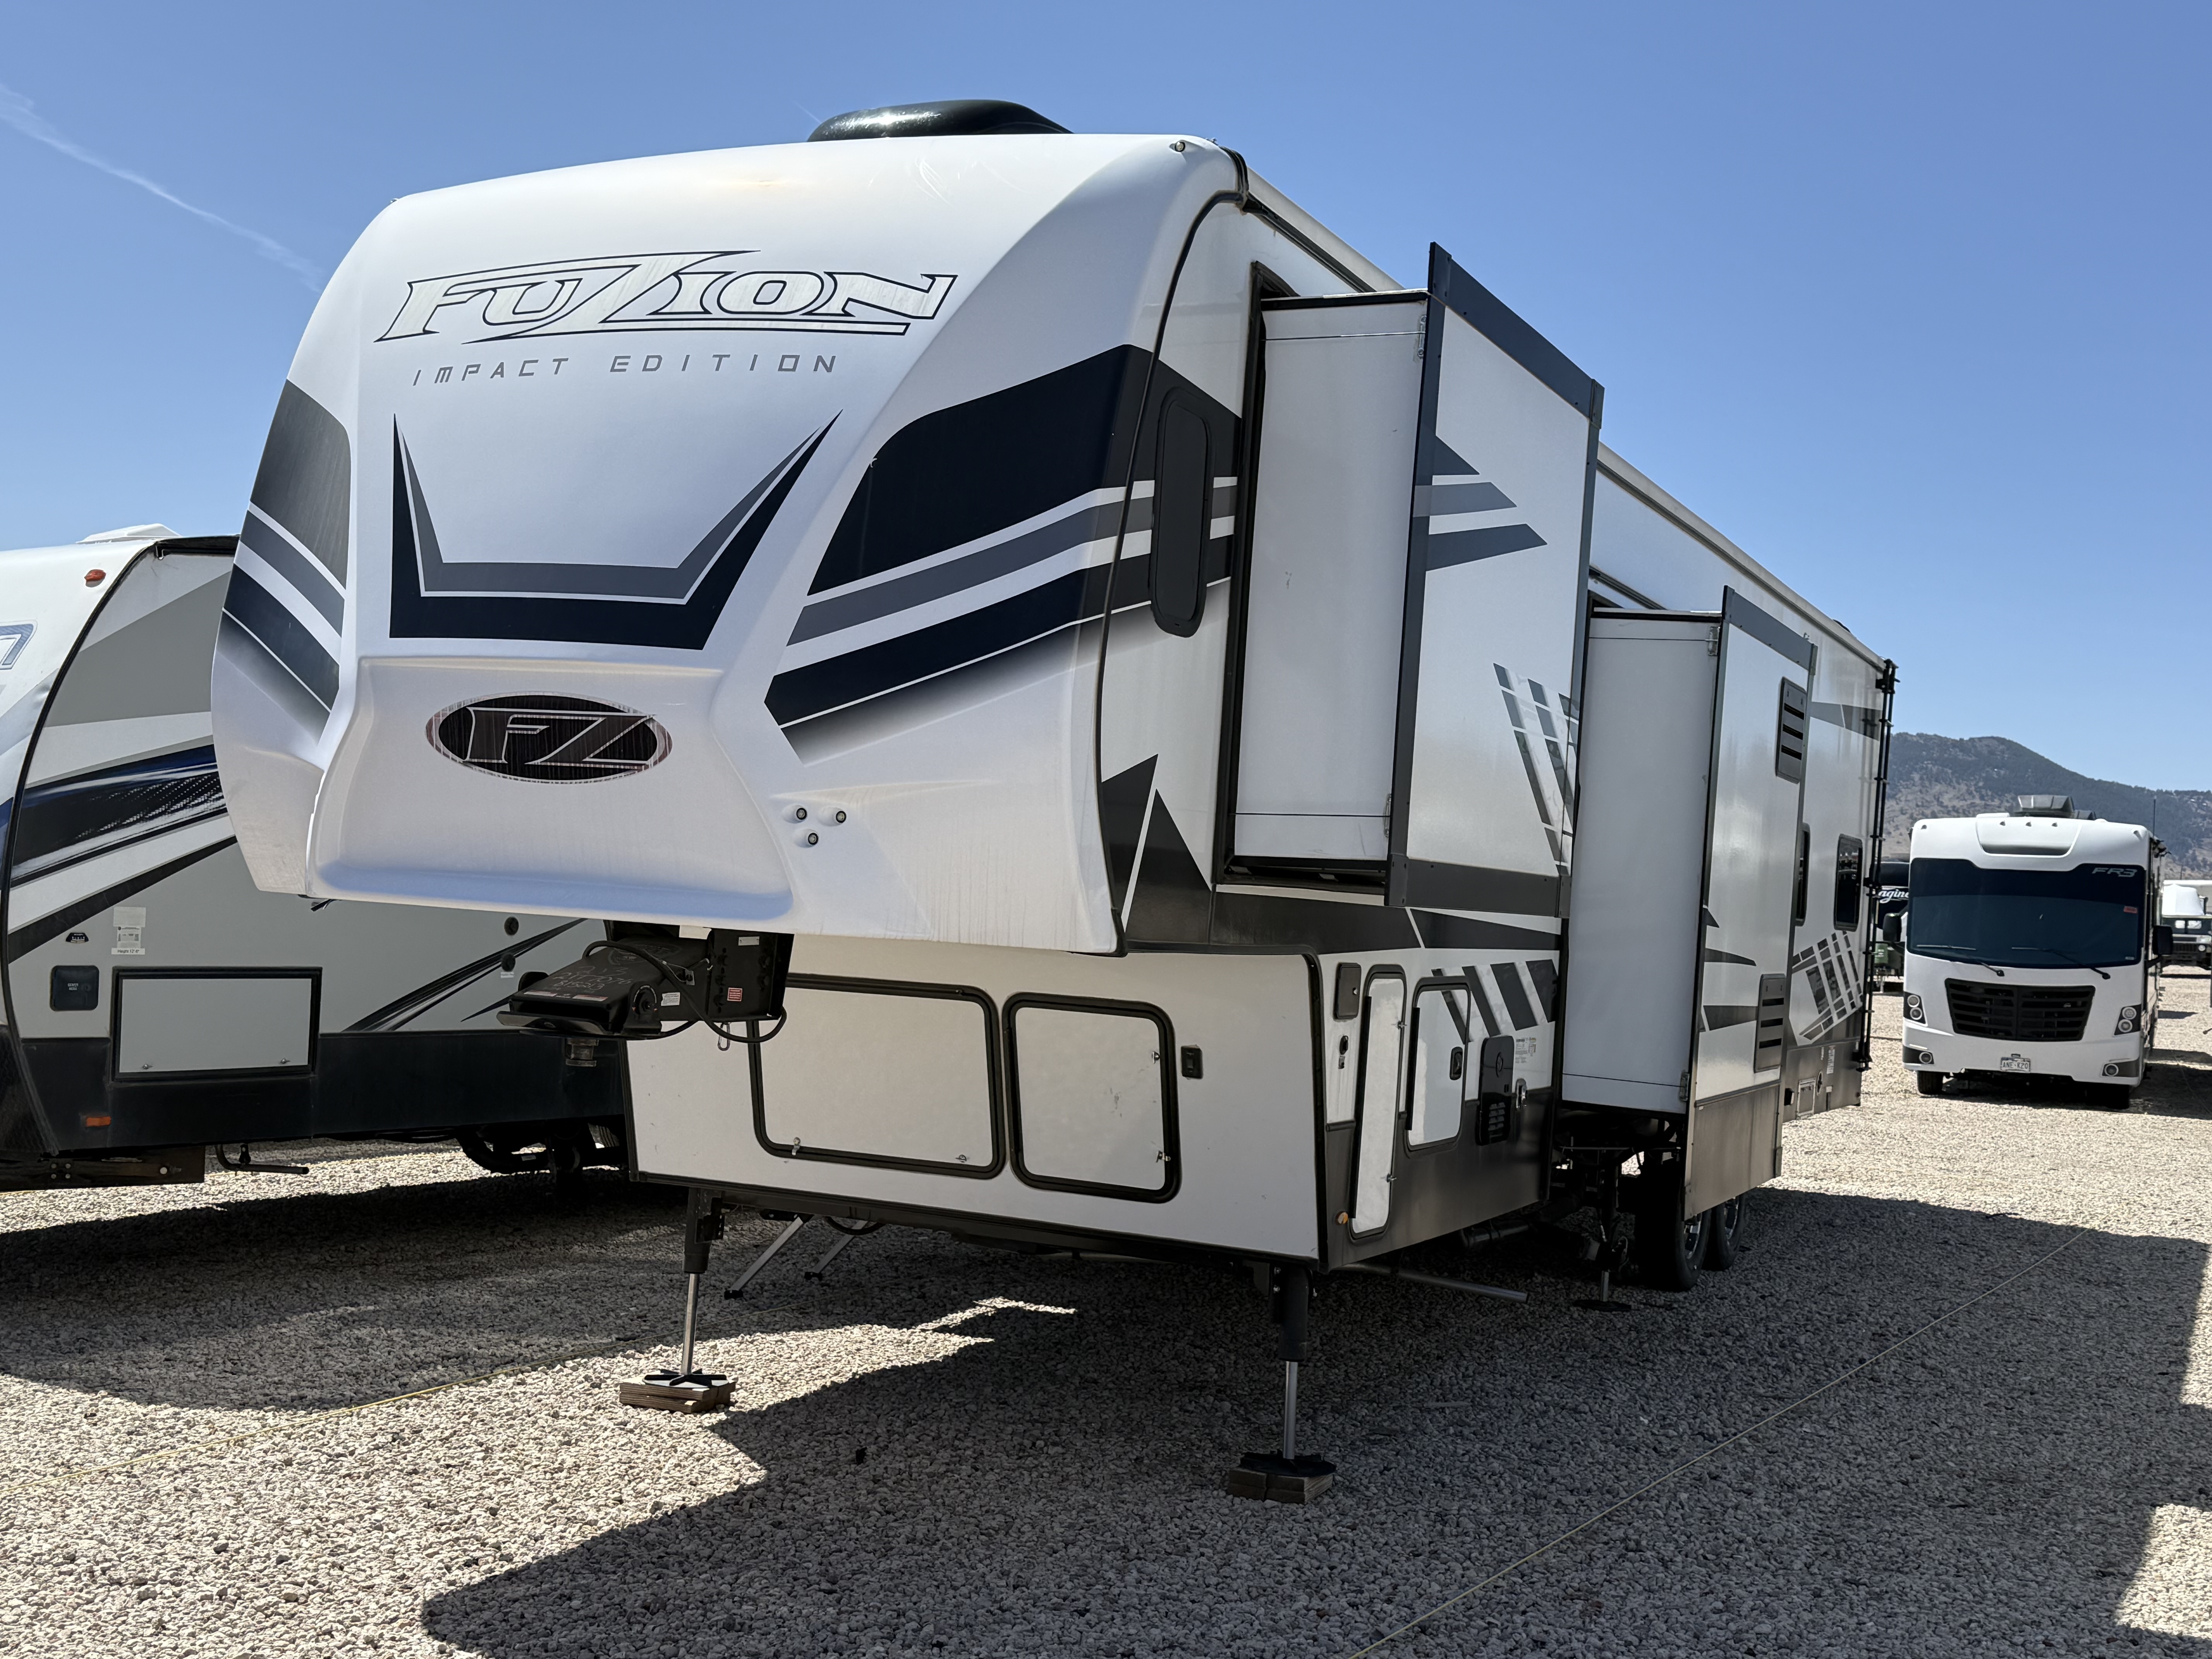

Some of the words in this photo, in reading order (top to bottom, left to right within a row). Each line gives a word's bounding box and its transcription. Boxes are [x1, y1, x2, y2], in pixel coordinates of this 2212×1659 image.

[413, 357, 568, 386] IMPACT
[610, 354, 836, 374] EDITION
[463, 707, 657, 769] FZ
[2092, 867, 2138, 877] FR3
[1878, 889, 1909, 903] agine
